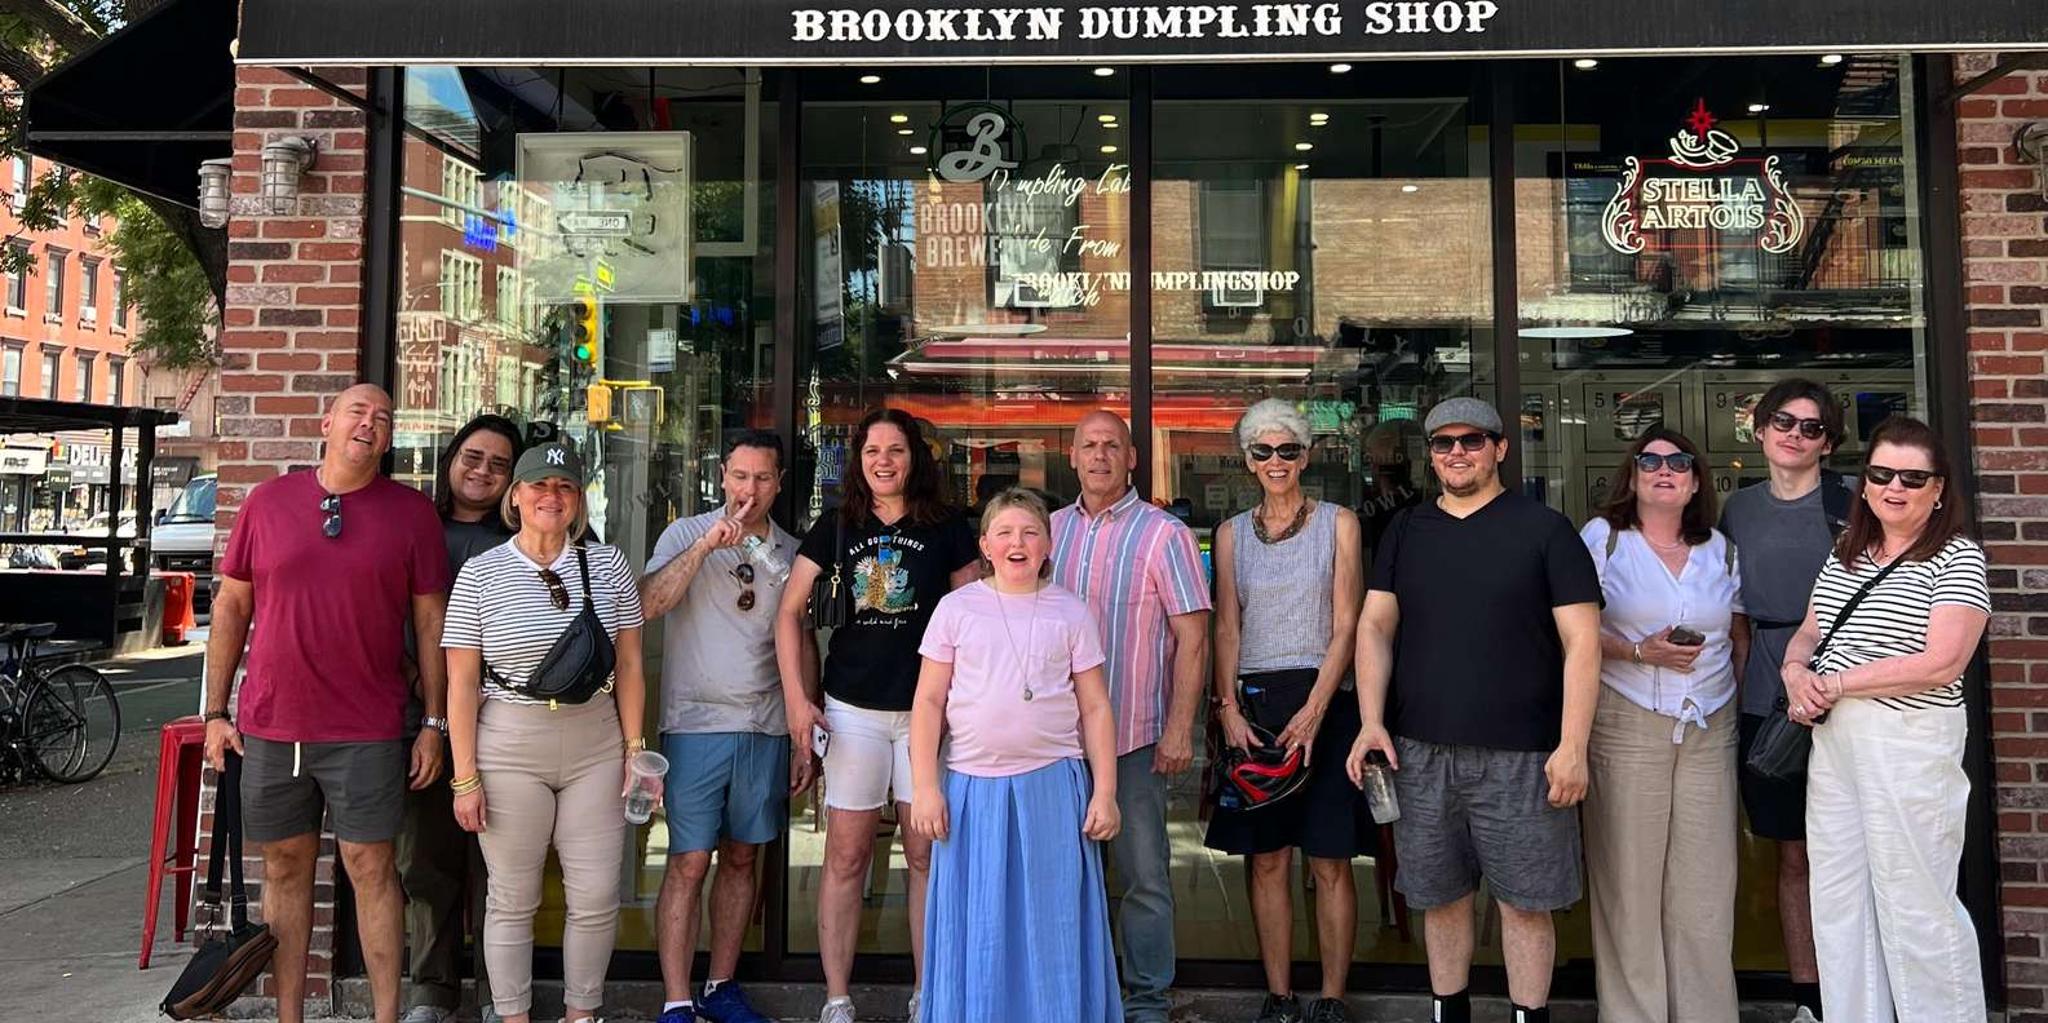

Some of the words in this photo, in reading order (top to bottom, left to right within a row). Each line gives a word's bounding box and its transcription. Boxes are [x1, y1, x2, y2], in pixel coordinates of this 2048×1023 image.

[791, 7, 1065, 42] BROOKLYN
[1079, 3, 1342, 40] DUMPLING
[1364, 0, 1498, 35] SHOP
[938, 112, 1019, 184] B
[1642, 177, 1766, 203] STELLA
[920, 202, 1036, 235] BROOKLYN
[1641, 204, 1766, 231] ARTOIS
[1063, 225, 1121, 258] From
[1595, 393, 1605, 408] 5
[1716, 393, 1727, 408] 9
[71, 445, 101, 467] DELI
[547, 448, 565, 465] NY
[1715, 477, 1731, 492] 10
[849, 542, 865, 556] ALL
[892, 535, 925, 551] THINGS
